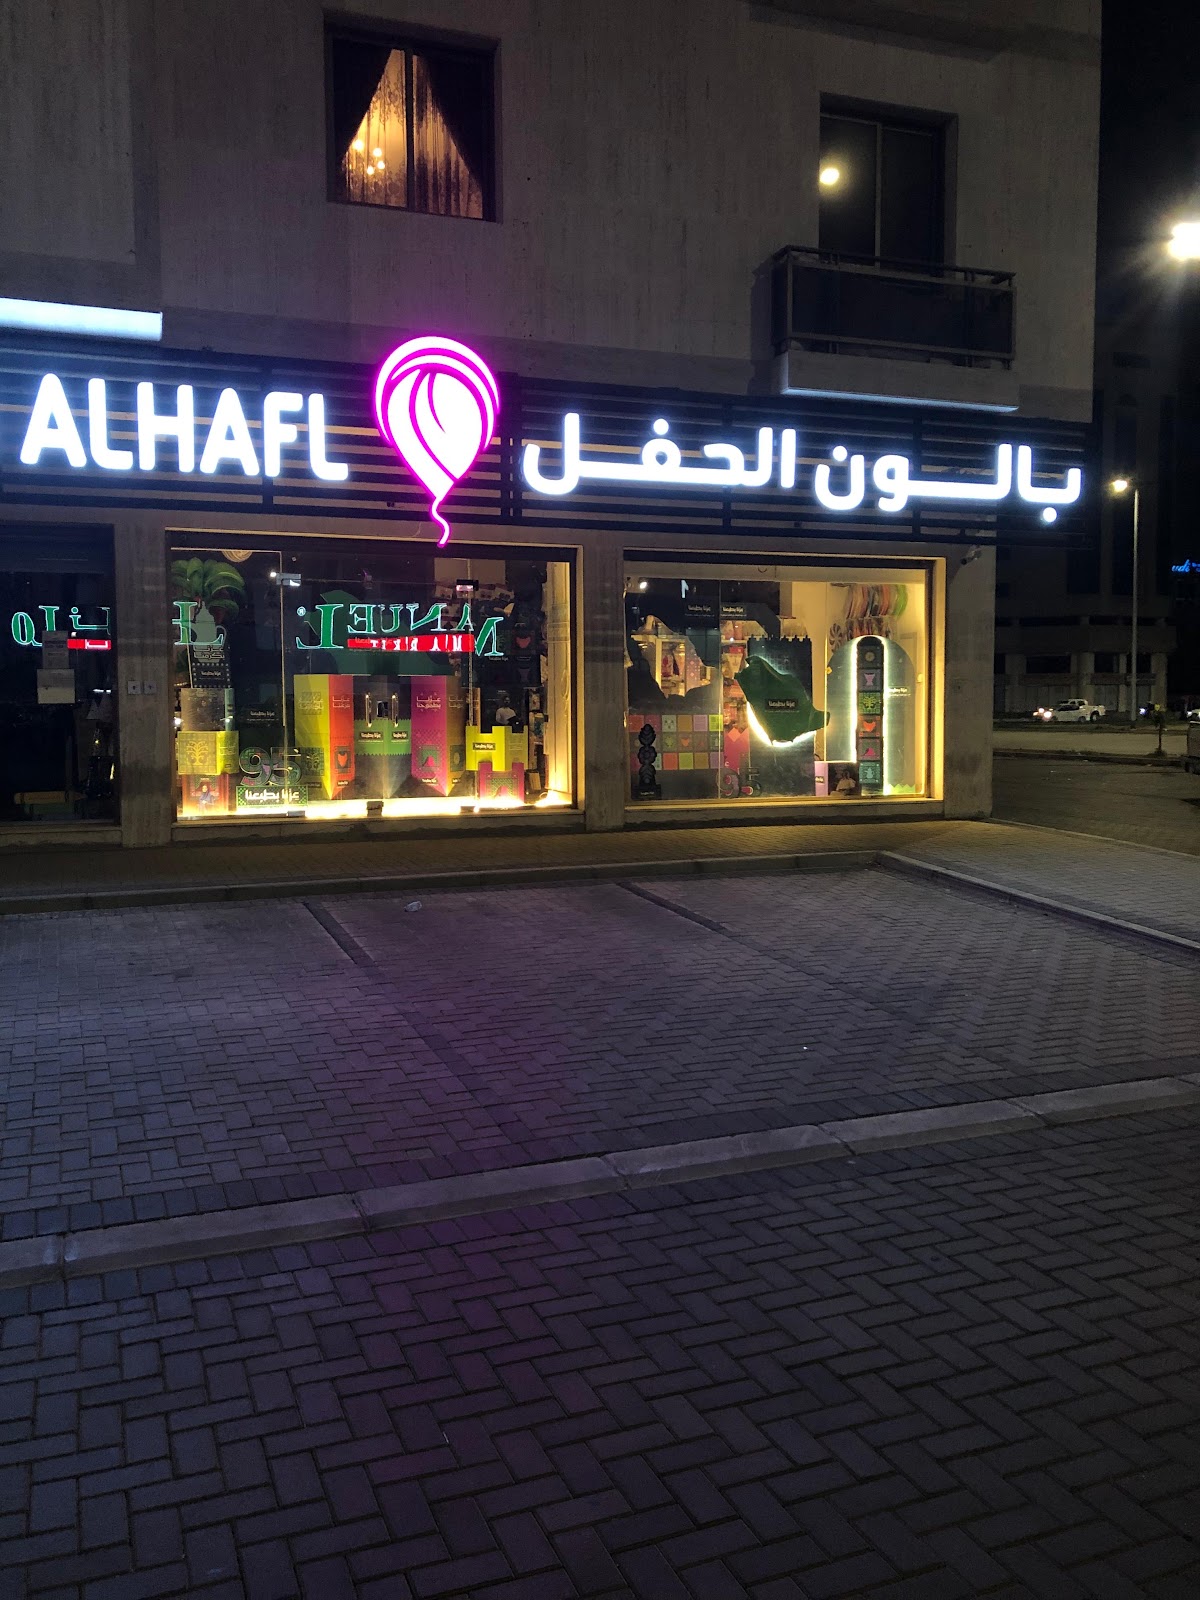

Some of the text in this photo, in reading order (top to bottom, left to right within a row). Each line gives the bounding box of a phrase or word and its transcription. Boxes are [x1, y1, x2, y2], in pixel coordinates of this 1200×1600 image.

[19, 372, 350, 482] ALHAFL
[522, 411, 1083, 525] بالون الحفل
[281, 788, 300, 803] عزنا
